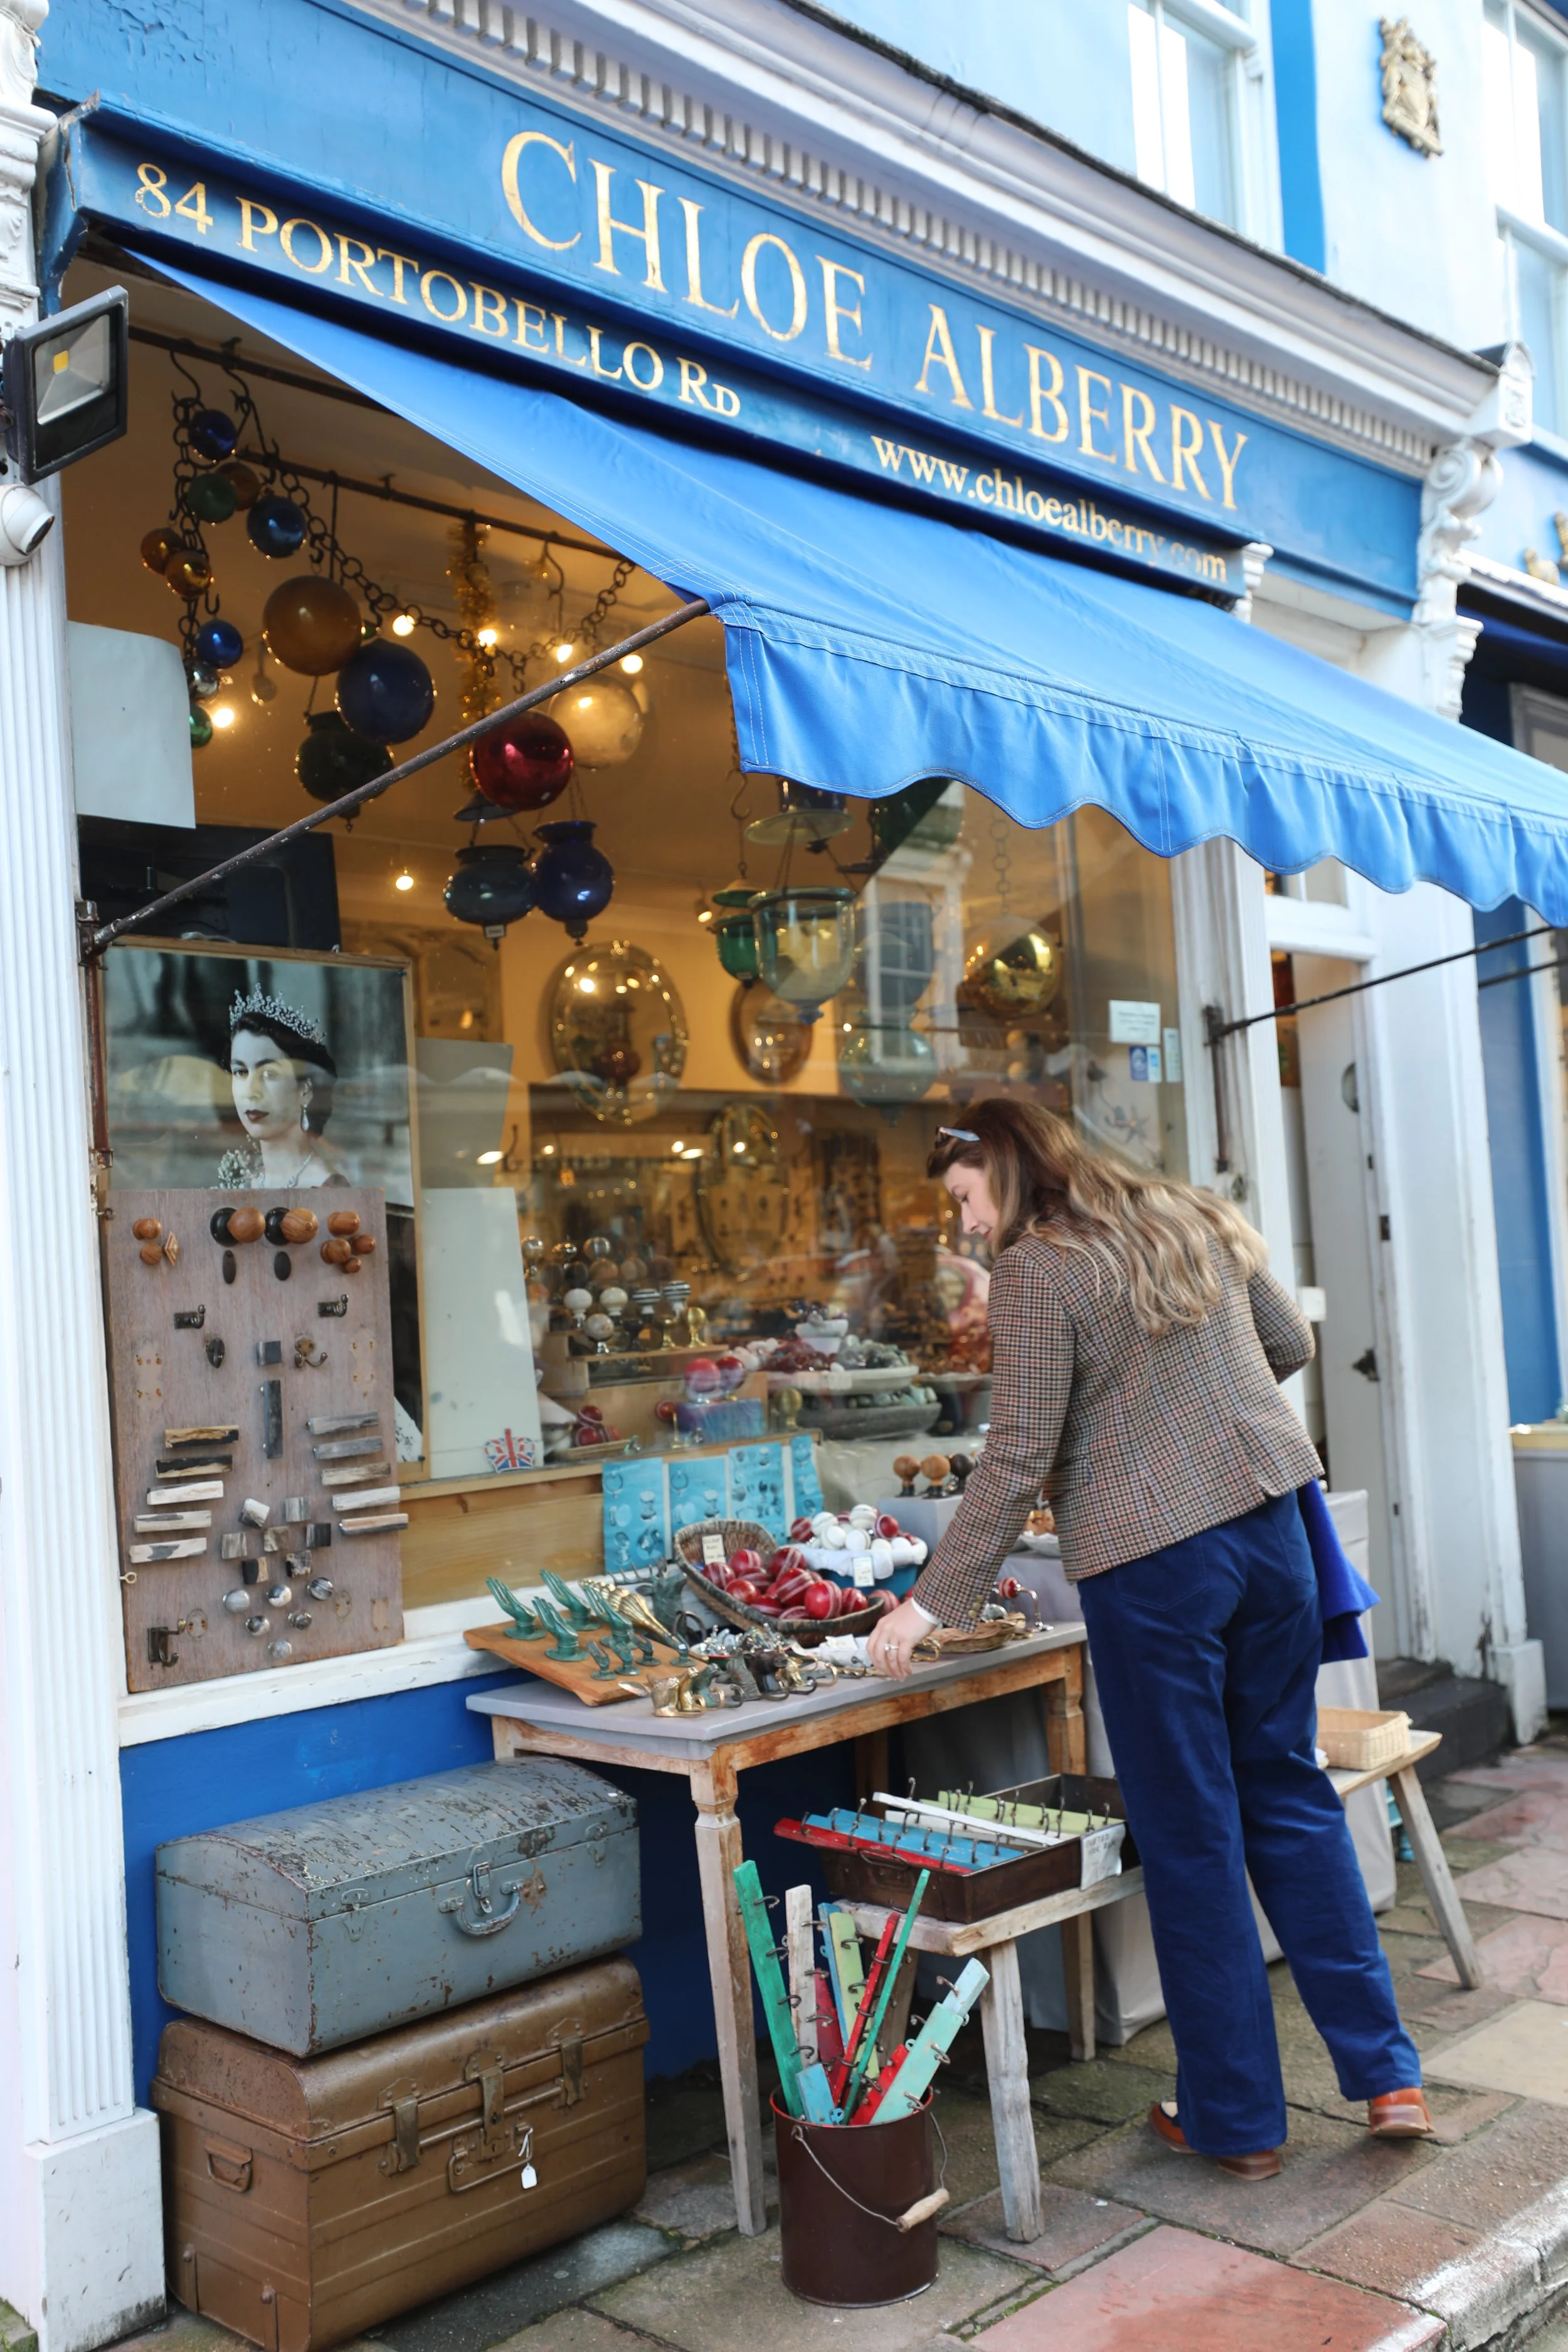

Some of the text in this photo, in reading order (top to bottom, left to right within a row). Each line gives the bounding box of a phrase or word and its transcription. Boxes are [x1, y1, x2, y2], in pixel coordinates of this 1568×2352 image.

[134, 162, 214, 235] 84
[236, 196, 664, 391] PORTOBELLO
[501, 130, 1249, 511] CHLOE ALBERRY
[870, 435, 1228, 583] www.chloealberrycom
